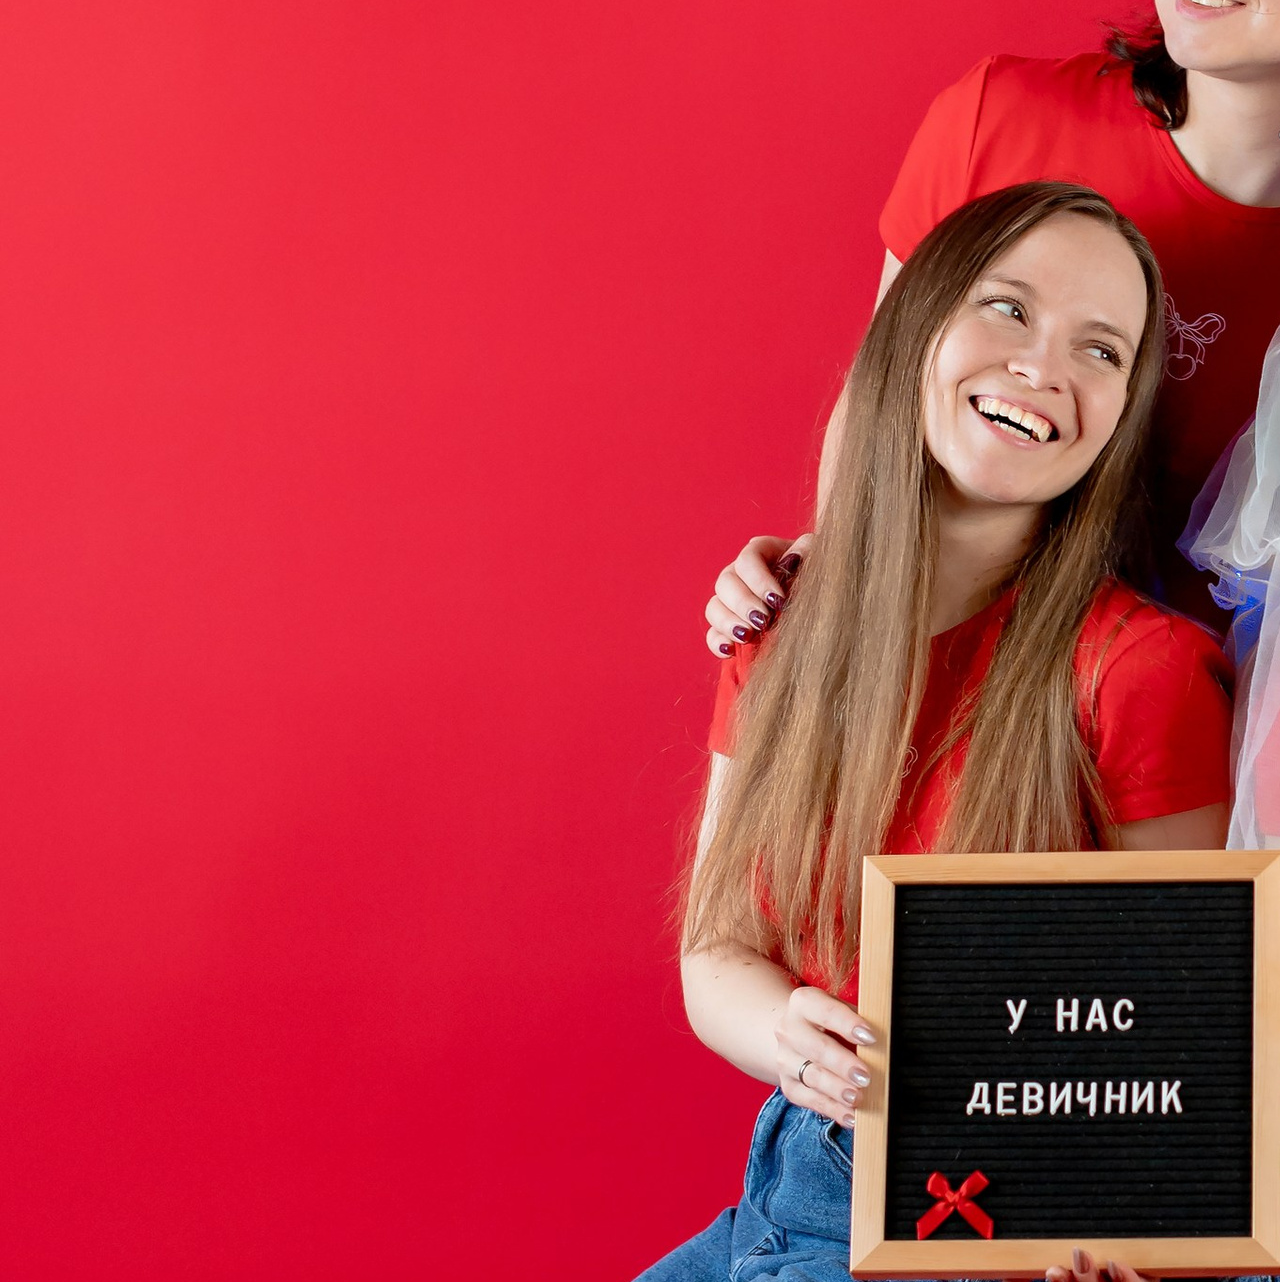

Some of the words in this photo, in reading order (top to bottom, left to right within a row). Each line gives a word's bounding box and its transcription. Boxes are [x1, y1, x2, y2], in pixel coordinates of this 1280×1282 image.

[1005, 998, 1027, 1035] У
[1056, 998, 1136, 1033] НАС
[966, 1080, 1183, 1117] ДЕВИЧНИК
